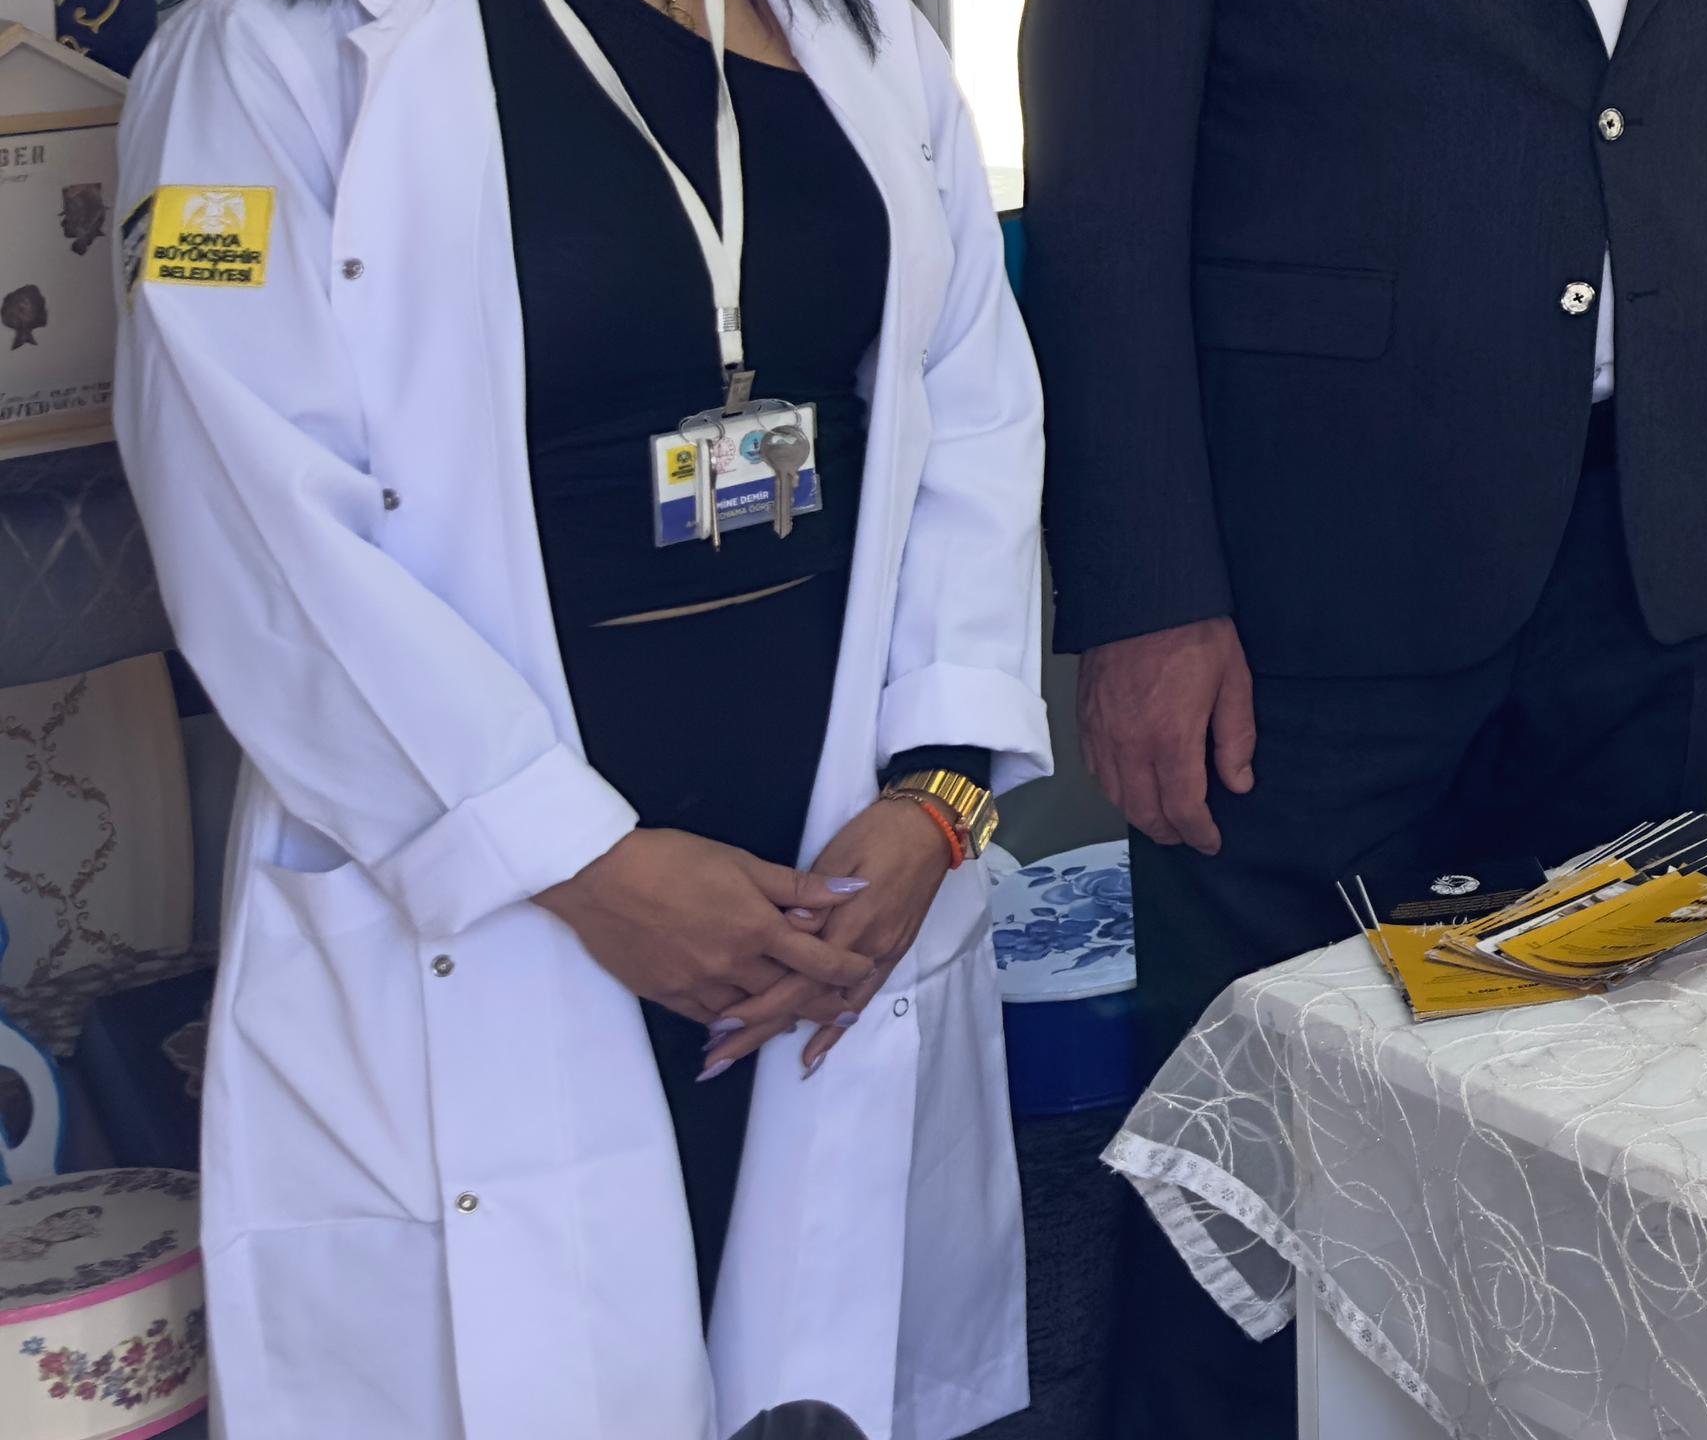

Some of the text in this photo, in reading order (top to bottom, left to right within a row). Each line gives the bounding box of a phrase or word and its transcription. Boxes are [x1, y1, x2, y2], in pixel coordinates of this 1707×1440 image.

[178, 232, 242, 248] KONYA
[154, 245, 263, 267] BÜYÜKŞEHİR
[159, 264, 253, 283] BELEDİYESİ
[716, 490, 770, 510] MİNE DEMİR
